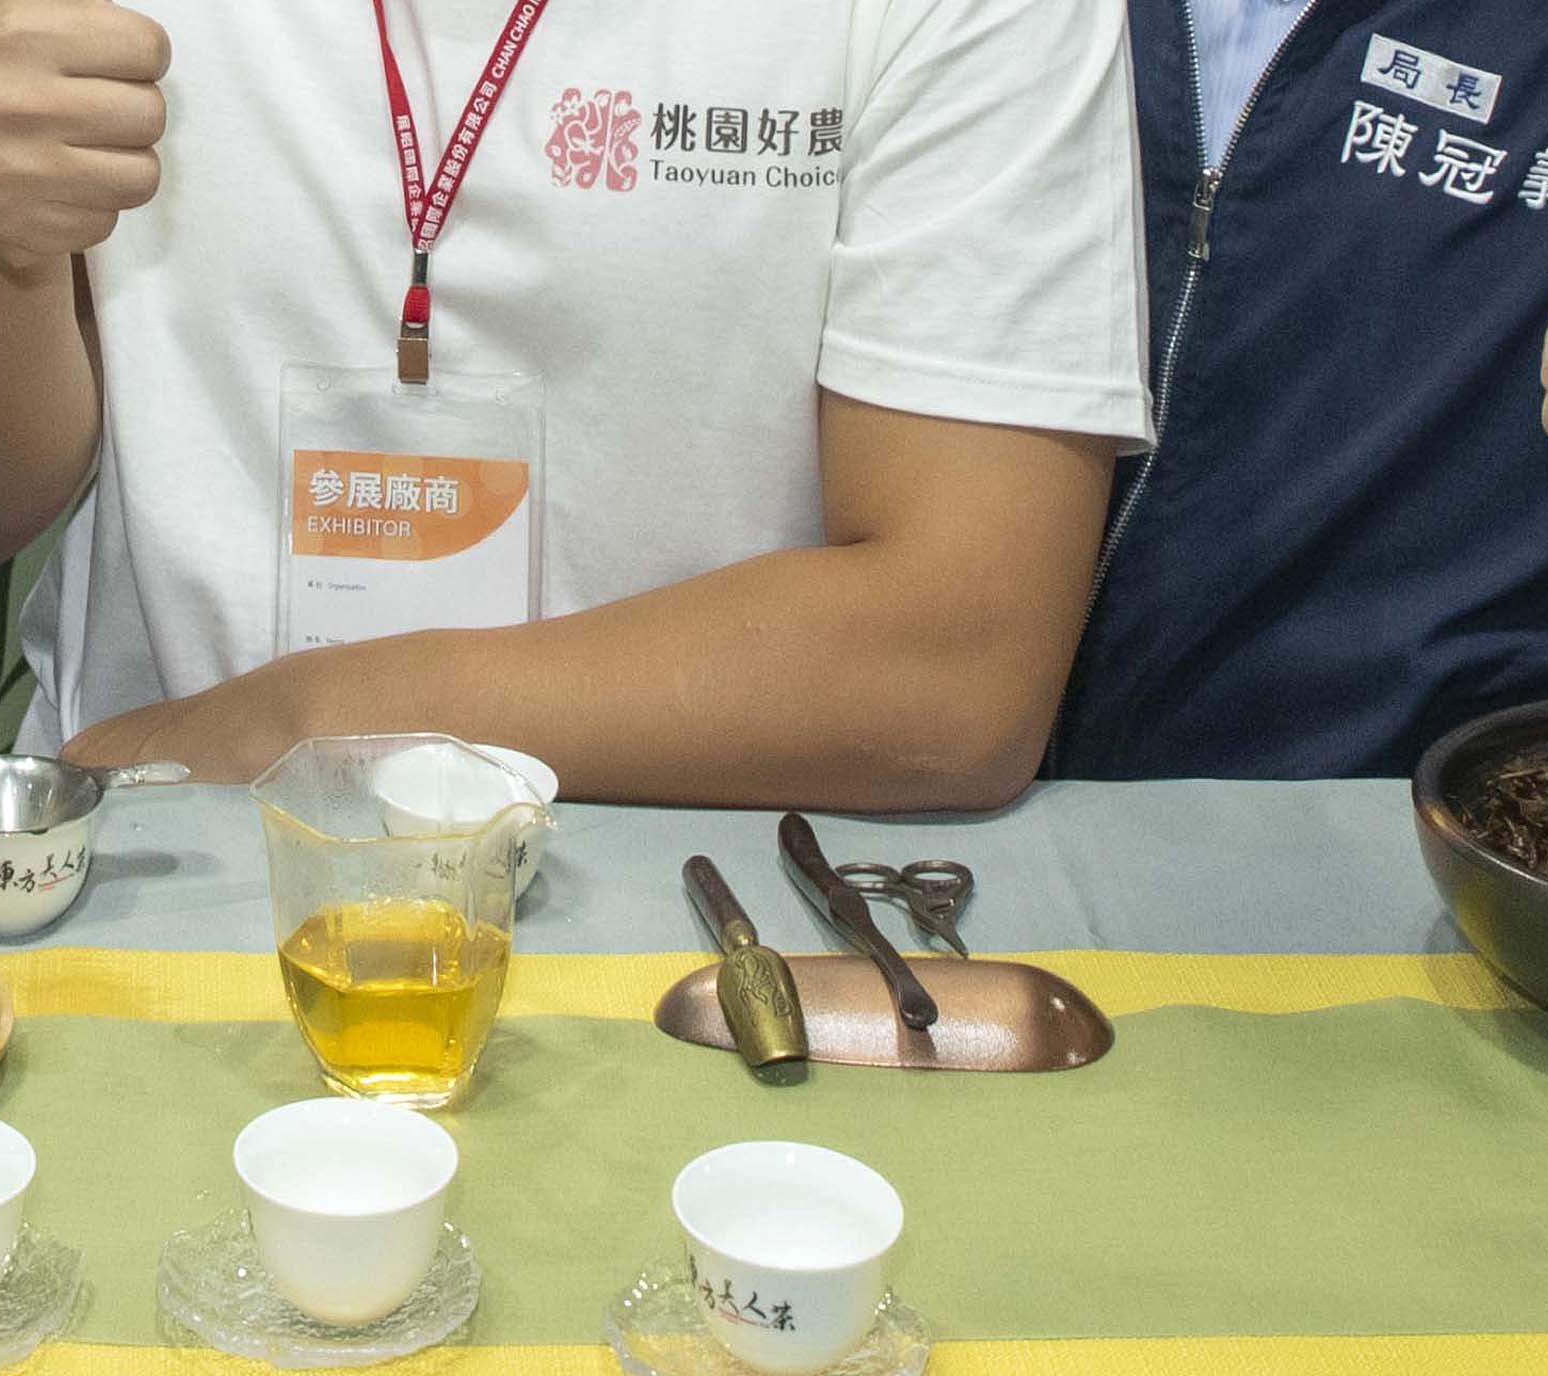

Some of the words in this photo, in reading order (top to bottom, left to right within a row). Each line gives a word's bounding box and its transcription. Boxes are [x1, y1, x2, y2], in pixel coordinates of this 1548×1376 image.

[488, 39, 520, 80] CHAN
[507, 3, 538, 43] CHAO
[1378, 49, 1482, 110] 局長
[650, 102, 843, 157] 桃園好農
[650, 159, 756, 187] Taoyuan
[309, 468, 460, 515] 參展廠商
[307, 515, 412, 537] EXHIBITOR
